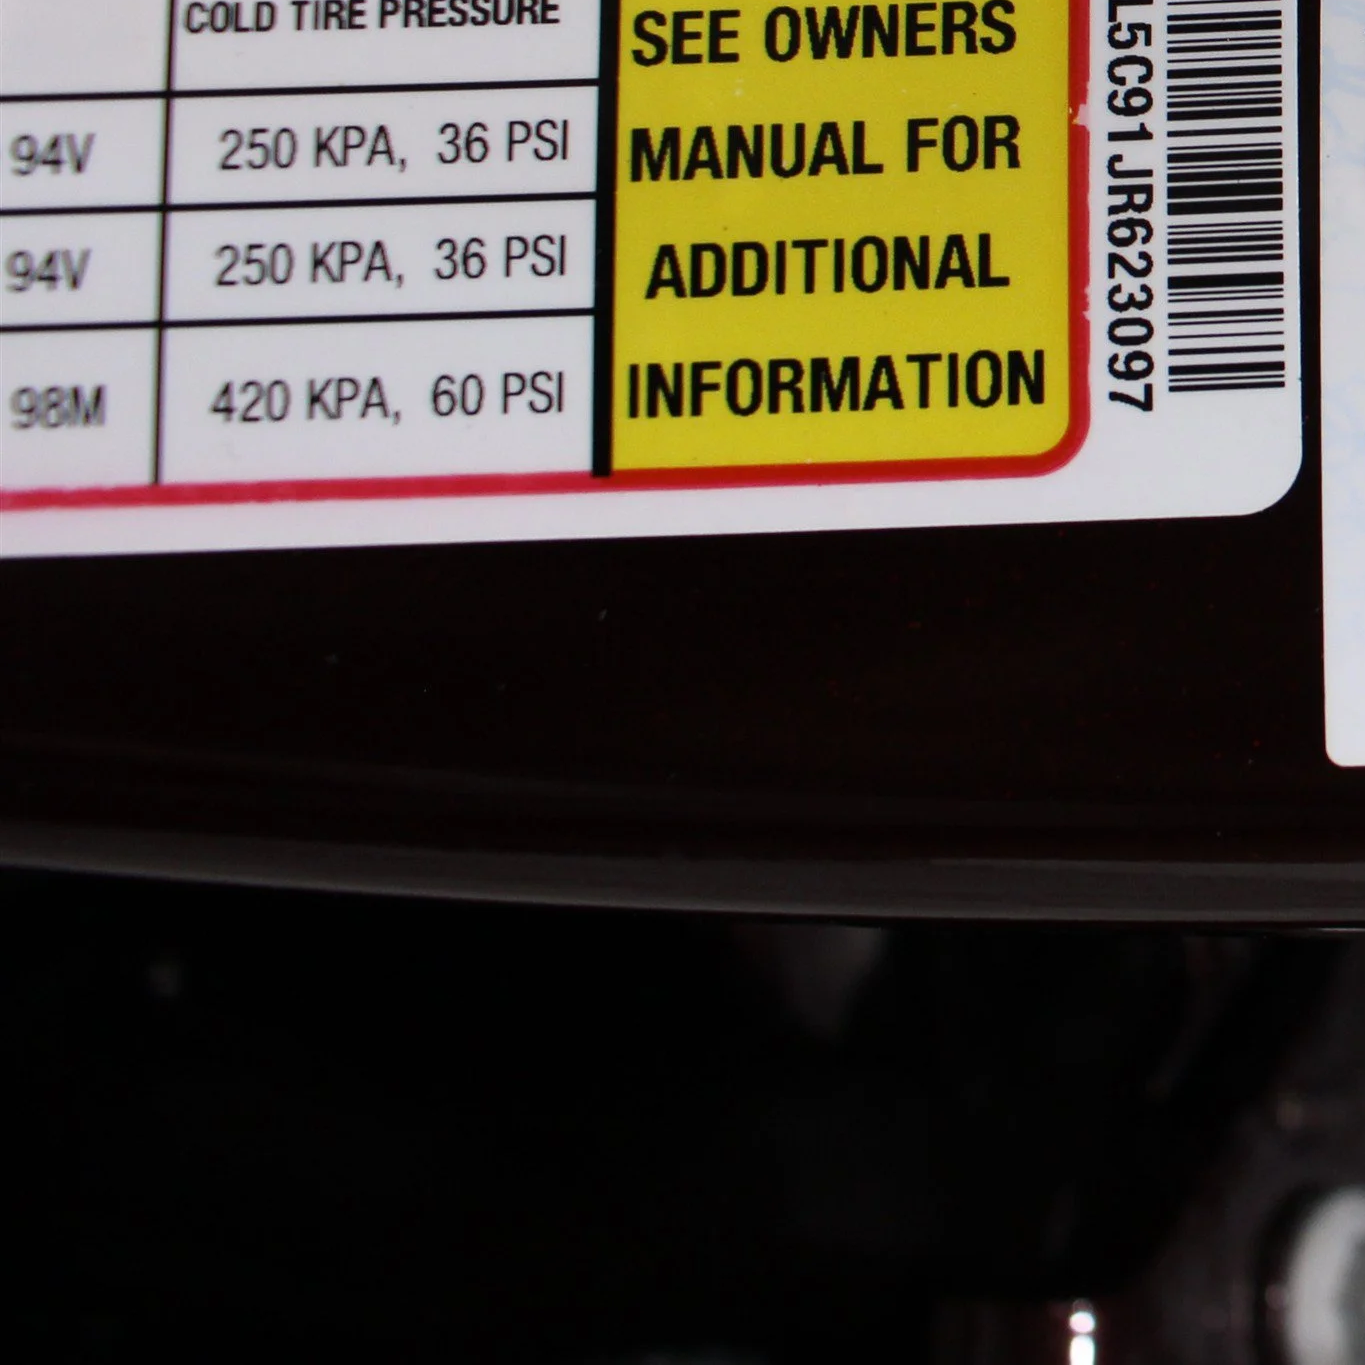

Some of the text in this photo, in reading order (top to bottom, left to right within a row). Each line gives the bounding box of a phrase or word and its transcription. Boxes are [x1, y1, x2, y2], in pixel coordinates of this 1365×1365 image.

[184, 1, 276, 34] COLD
[290, 0, 366, 31] TIRE
[631, 9, 740, 67] SEE
[12, 135, 91, 176] 94V
[220, 119, 568, 170] 250 KPA, 36 PSI
[630, 115, 1020, 182] MANUAL FOR
[8, 251, 88, 292] 94V
[216, 234, 565, 287] 250 KPA, 36 PSI
[645, 233, 1010, 299] ADDITIONAL
[211, 371, 563, 422] 420 KPA, 60 PSI
[628, 349, 1044, 419] INFORMATION
